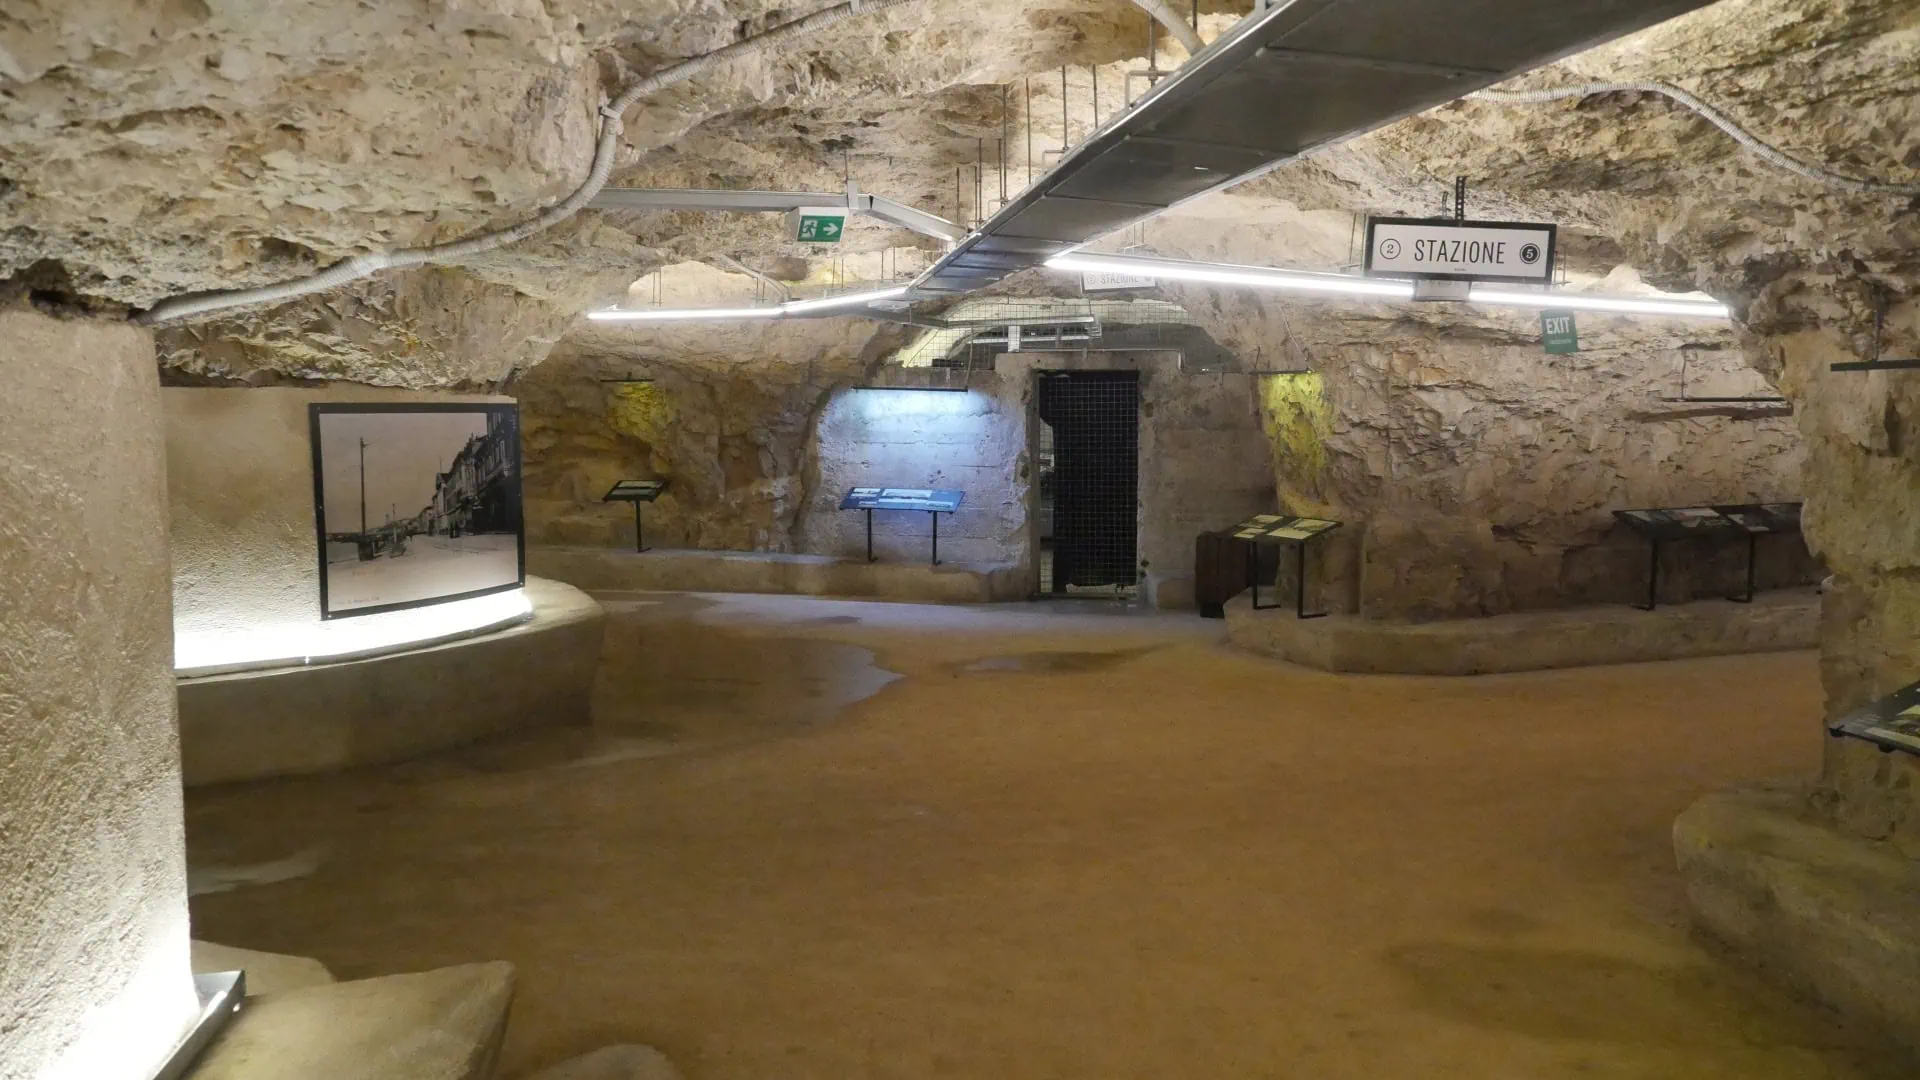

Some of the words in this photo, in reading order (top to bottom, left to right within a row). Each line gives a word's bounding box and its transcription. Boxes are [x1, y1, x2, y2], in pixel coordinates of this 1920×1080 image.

[1386, 244, 1394, 254] 2
[1414, 239, 1507, 265] STAZIONE
[1526, 249, 1534, 259] 5
[1545, 316, 1570, 335] EXIT
